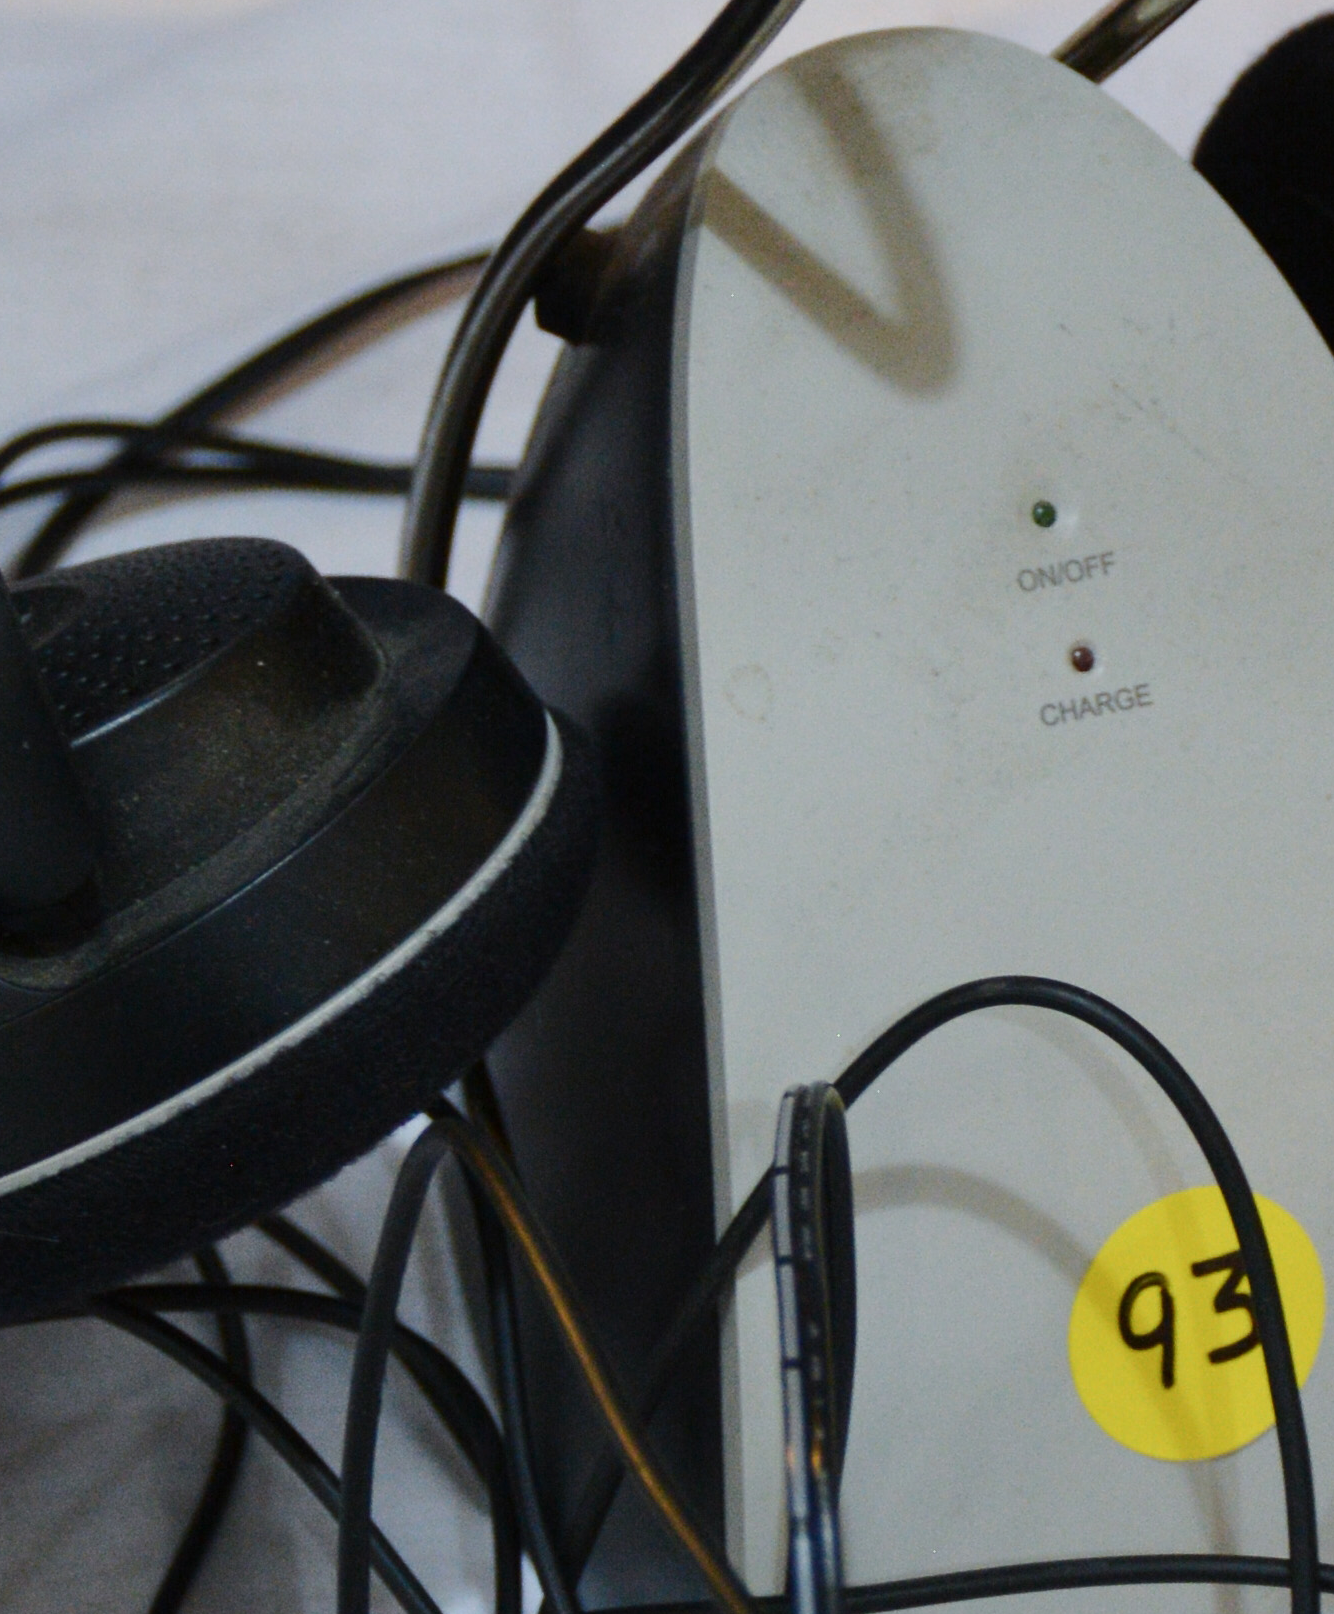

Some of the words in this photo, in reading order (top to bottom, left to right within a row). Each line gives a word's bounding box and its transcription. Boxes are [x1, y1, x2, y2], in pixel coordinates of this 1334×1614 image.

[1017, 551, 1116, 592] ON/OFF
[1039, 683, 1154, 727] CHARGE
[1118, 1248, 1267, 1390] 93
